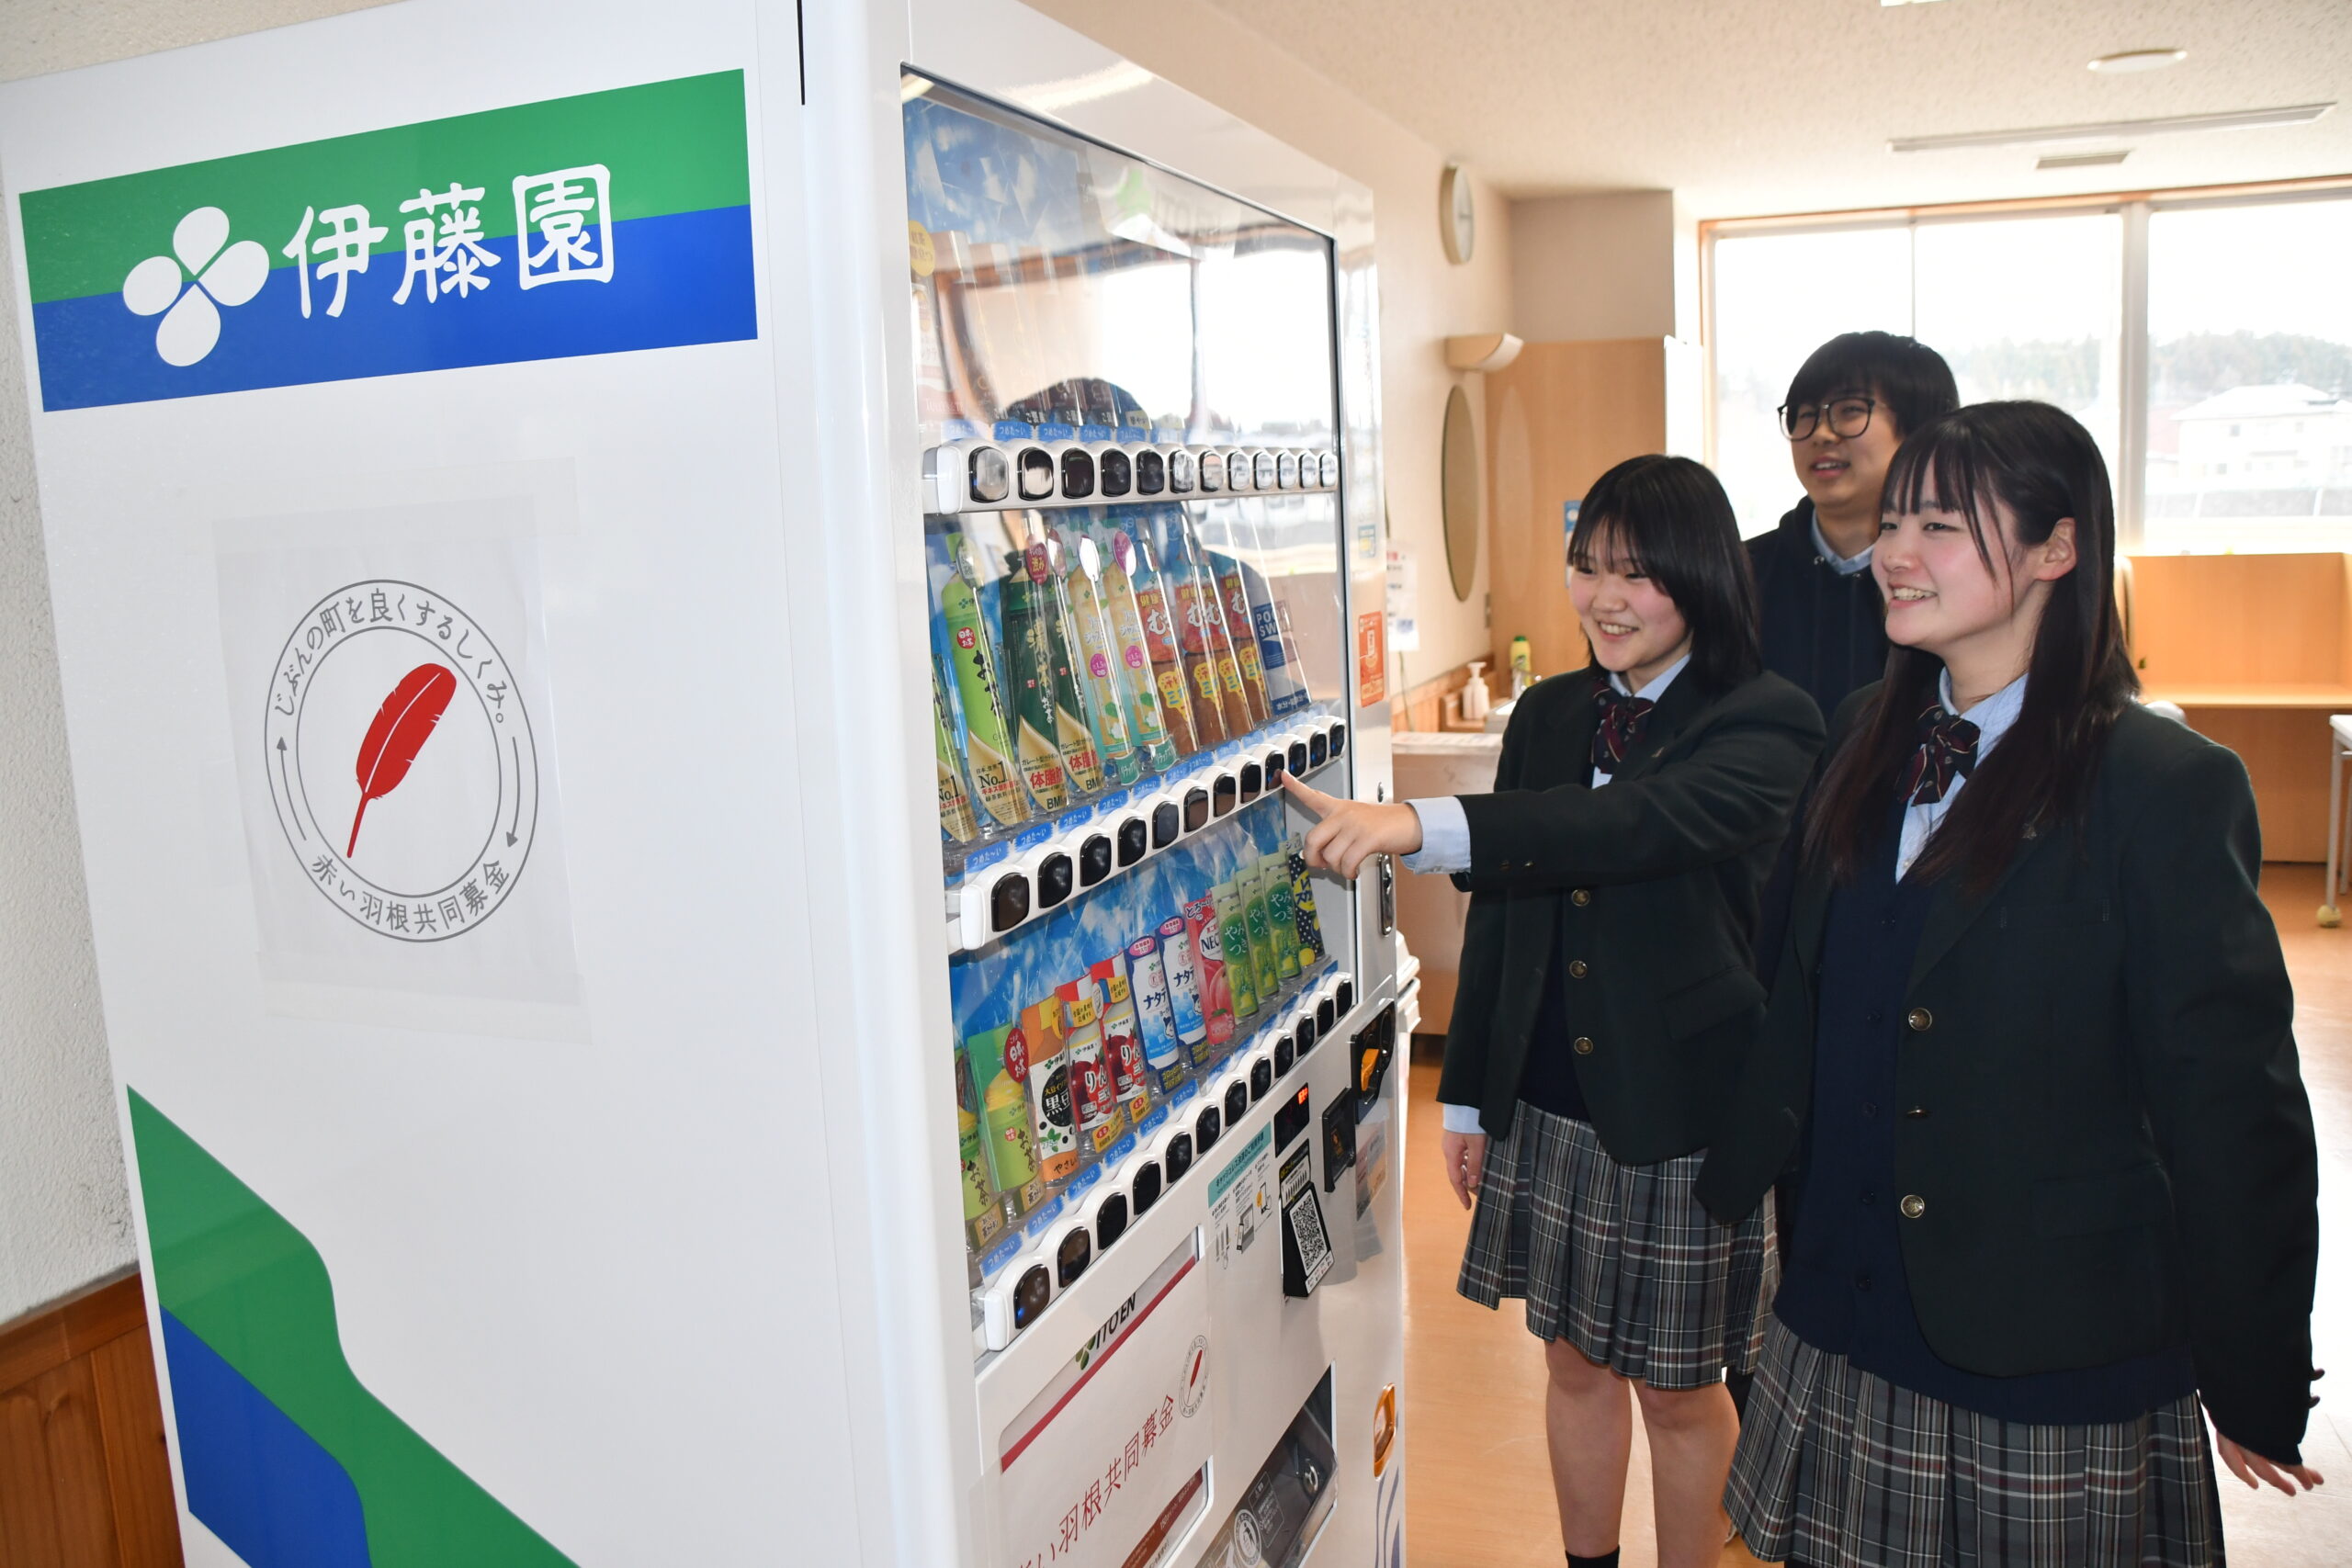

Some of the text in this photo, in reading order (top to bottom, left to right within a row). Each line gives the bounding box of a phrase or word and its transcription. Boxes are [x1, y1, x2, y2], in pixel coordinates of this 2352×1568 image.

[283, 163, 615, 319] 伊藤園
[274, 588, 507, 724] じぶんの町を良くするしくみ。
[978, 761, 1008, 789] No.1
[1102, 795, 1124, 809] つめた〜い
[1064, 810, 1087, 825] つめた〜い
[1021, 829, 1046, 845] つめた〜い
[973, 847, 1002, 865] つめた〜い
[311, 854, 509, 935] 赤い羽根共同募金
[1144, 1111, 1164, 1131] つめた〜い
[1109, 1139, 1131, 1159] つめた〜い
[1072, 1169, 1096, 1191] つめた〜い
[1032, 1202, 1057, 1228] つめた〜い
[988, 1240, 1015, 1268] つめた〜い
[1020, 1394, 1174, 1568] い羽根共同募金
